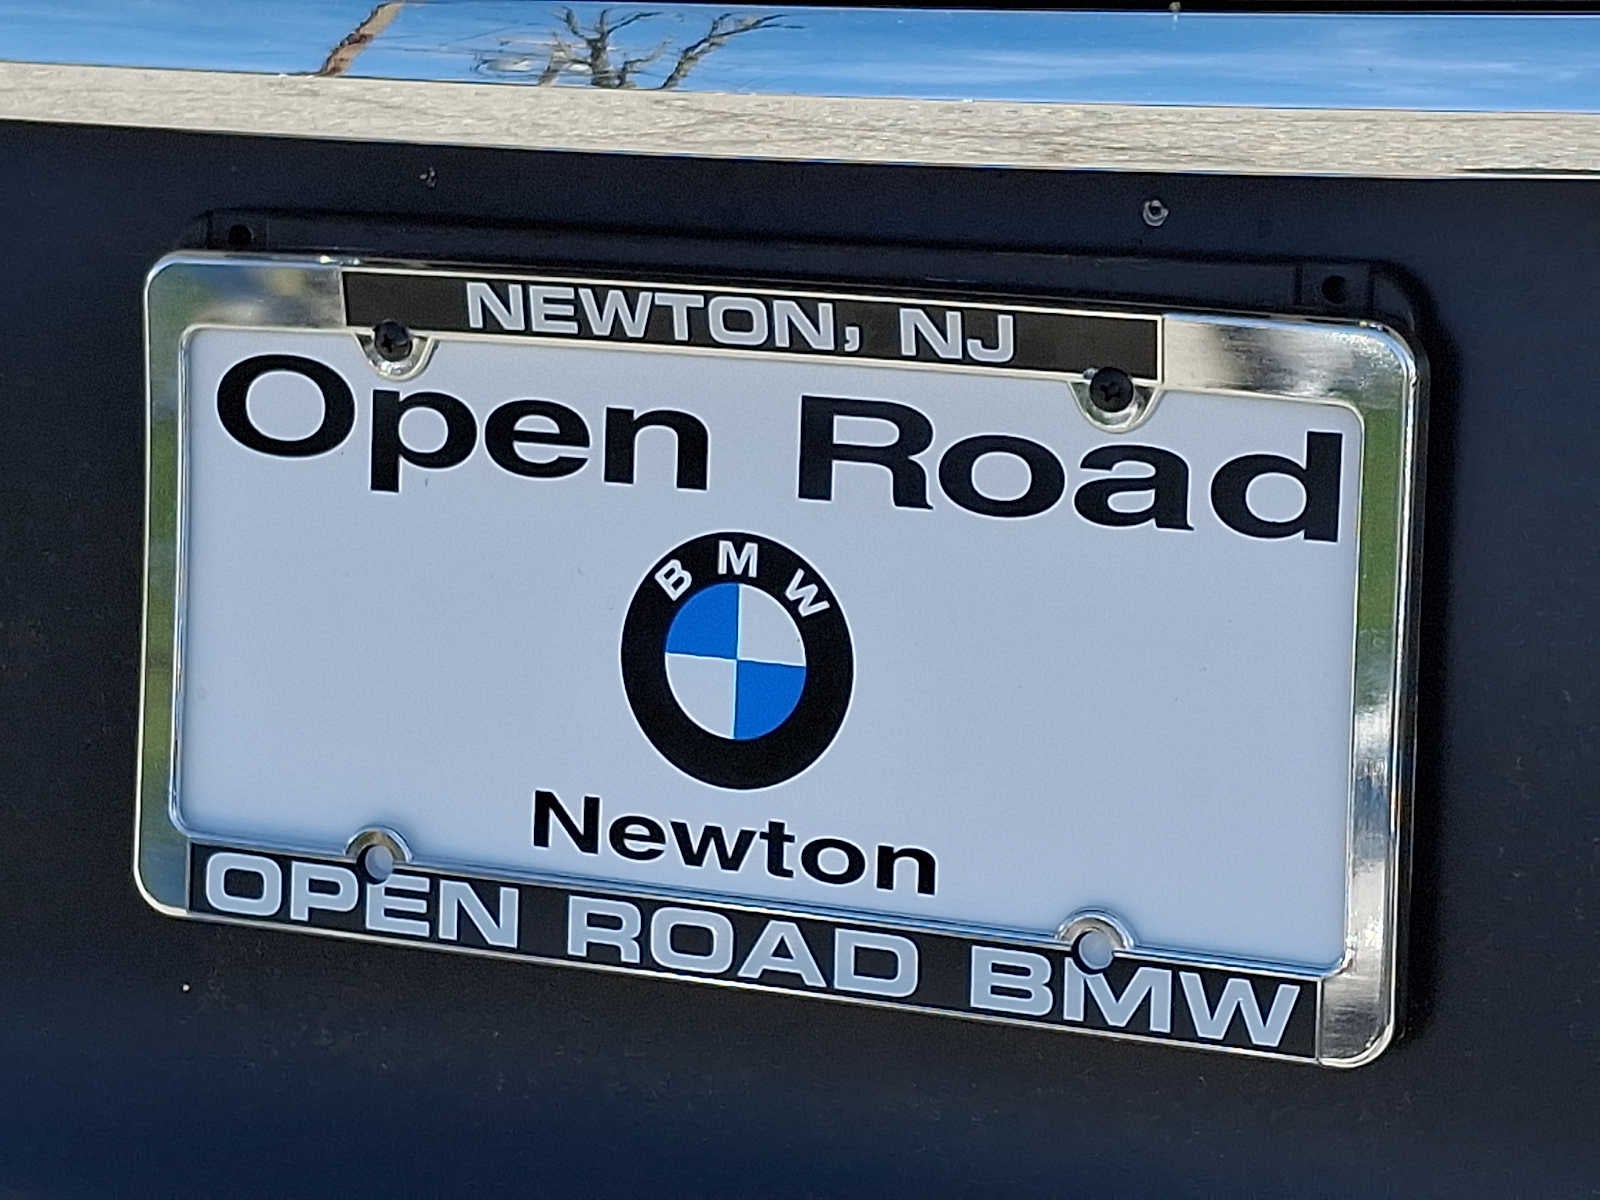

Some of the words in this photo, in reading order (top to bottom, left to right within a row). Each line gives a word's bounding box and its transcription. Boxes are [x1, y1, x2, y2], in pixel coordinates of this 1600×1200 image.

[465, 281, 861, 353] NEWTON,
[900, 308, 1016, 363] NJ
[217, 354, 708, 496] Open
[798, 395, 1343, 543] Road
[654, 540, 830, 617] BMW
[534, 790, 937, 896] Newton
[205, 852, 520, 949] OPEN
[567, 898, 919, 998] ROAD
[969, 945, 1300, 1048] BMW
